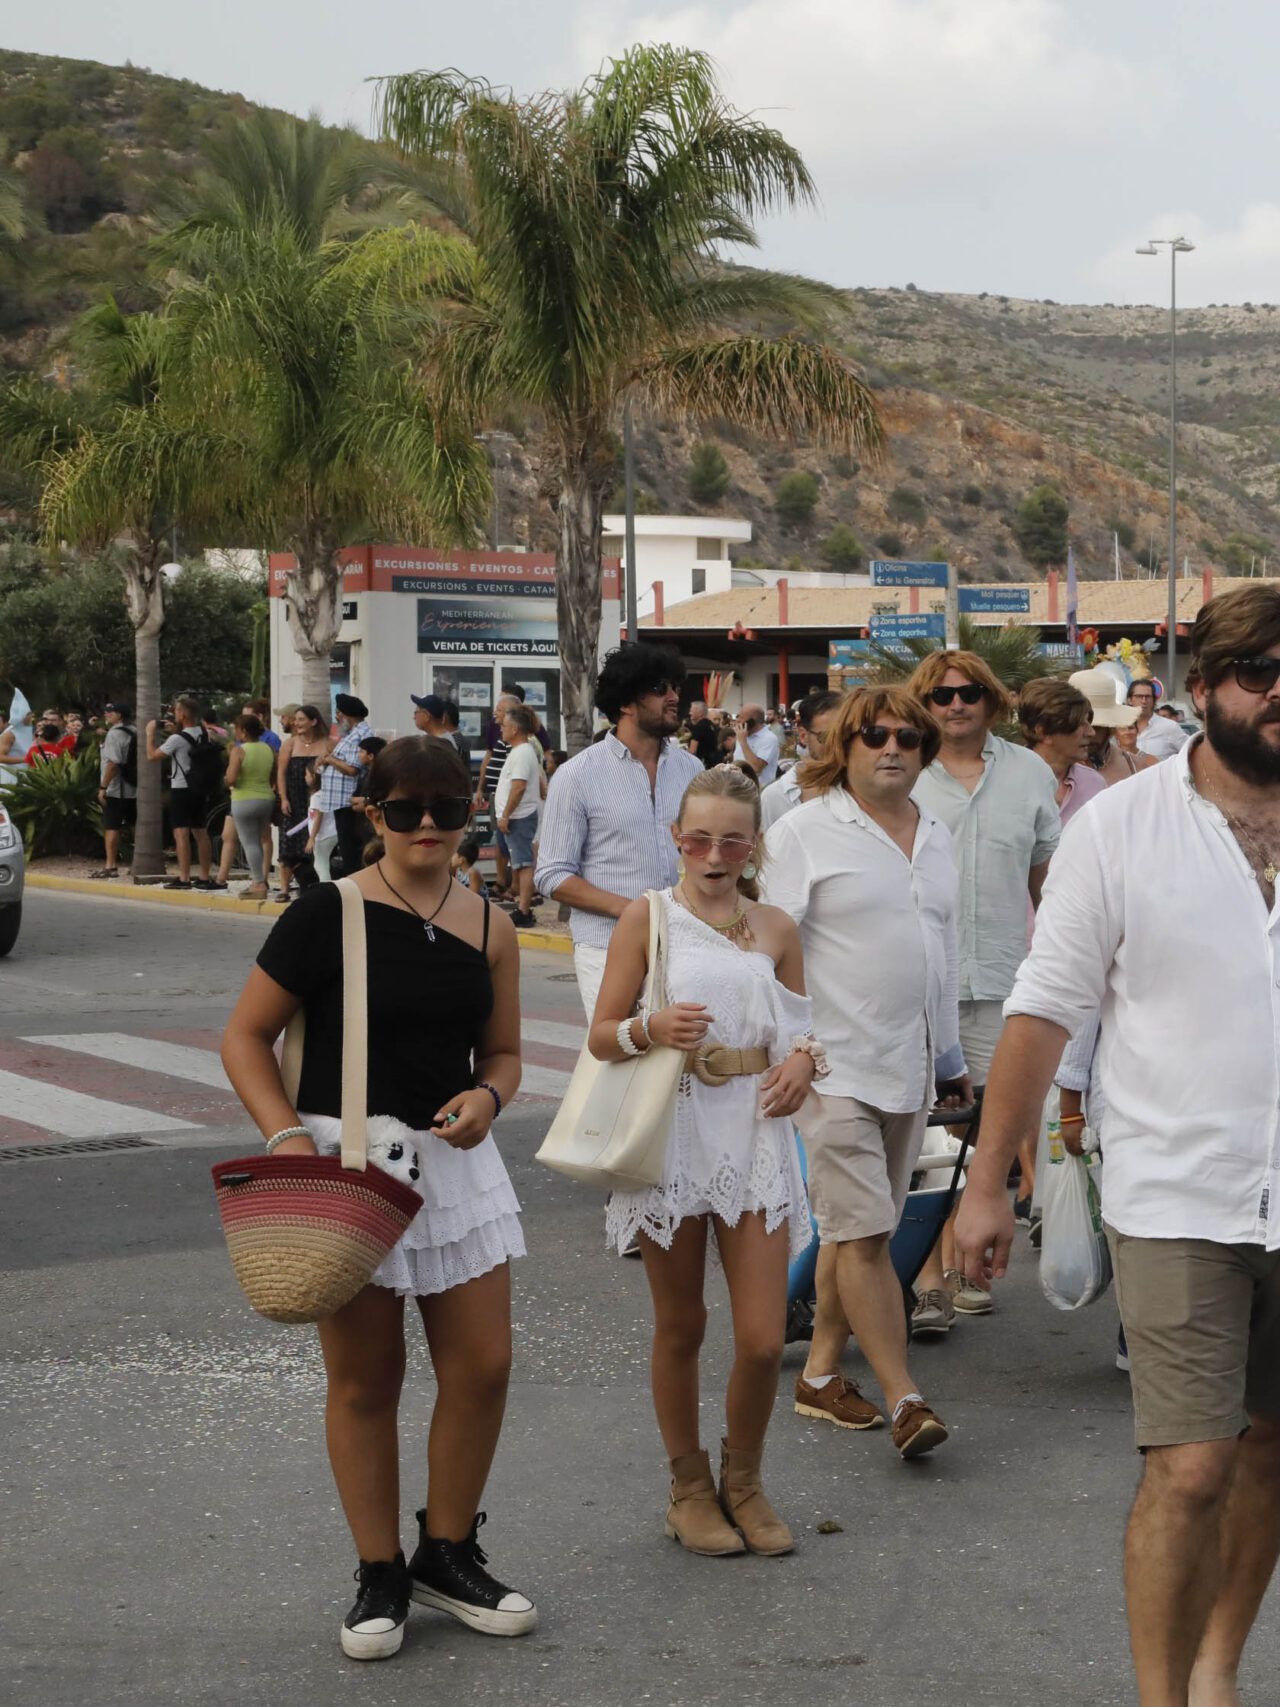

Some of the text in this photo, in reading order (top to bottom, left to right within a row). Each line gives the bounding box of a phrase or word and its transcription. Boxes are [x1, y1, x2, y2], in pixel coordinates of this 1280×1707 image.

[375, 559, 459, 571] EXCURSIONES
[469, 563, 523, 574] EVENTOS
[403, 581, 556, 594] EXCURSIONS EVENTS CATAM
[992, 603, 1020, 612] pesquero
[441, 610, 513, 619] MEDITERRANEAN
[421, 611, 518, 632] Experience
[880, 616, 927, 625] Zona esportiva
[880, 629, 927, 638] Zona deportiva
[433, 641, 557, 653] VENTA DE TICKETS AQUÍ
